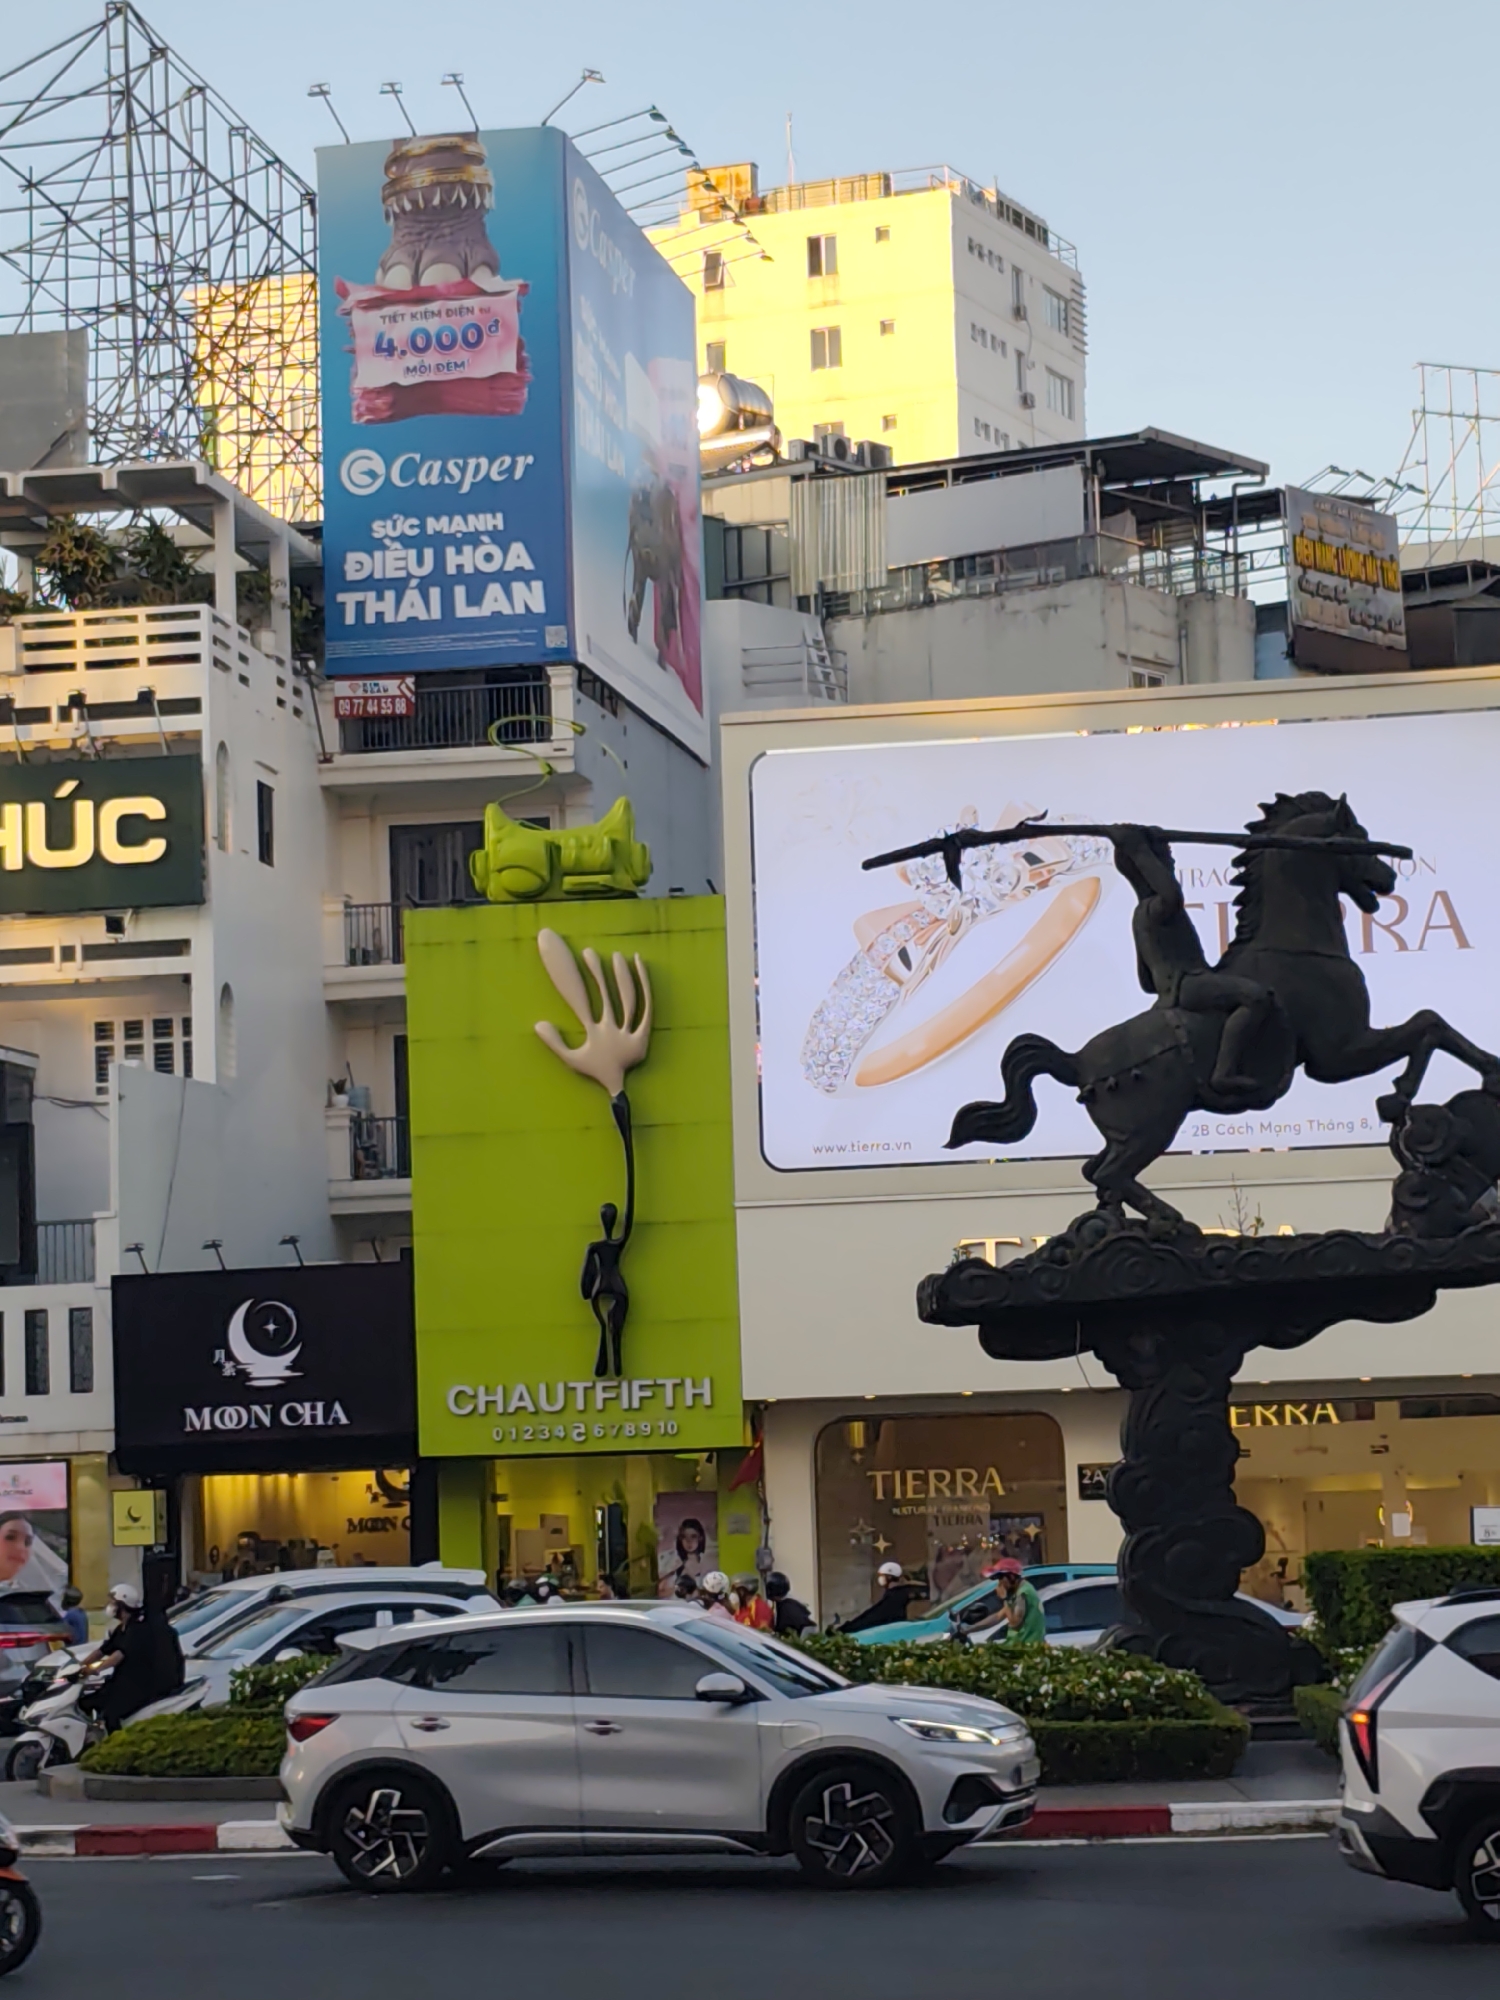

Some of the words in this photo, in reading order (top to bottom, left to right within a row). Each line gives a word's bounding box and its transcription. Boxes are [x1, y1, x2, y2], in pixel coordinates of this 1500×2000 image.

[374, 317, 501, 358] 4.000đ
[389, 453, 534, 494] Casper
[371, 514, 421, 538] SỨC
[426, 512, 504, 538] MẠNH
[344, 538, 434, 581] ĐIỀU
[445, 535, 535, 575] HÒA
[336, 578, 442, 625] THÁI
[454, 580, 546, 618] LAN
[1192, 1124, 1210, 1138] 2B
[1216, 1122, 1254, 1136] Cách
[1260, 1120, 1301, 1138] Mạng
[1307, 1119, 1354, 1134] Tháng
[813, 1141, 912, 1155] www.tierra.vn
[447, 1377, 712, 1416] CHAUTFIFTH
[184, 1406, 273, 1432] MOON
[280, 1400, 350, 1426] CHA
[866, 1467, 1006, 1500] TIERRA
[346, 1516, 398, 1535] MOON
